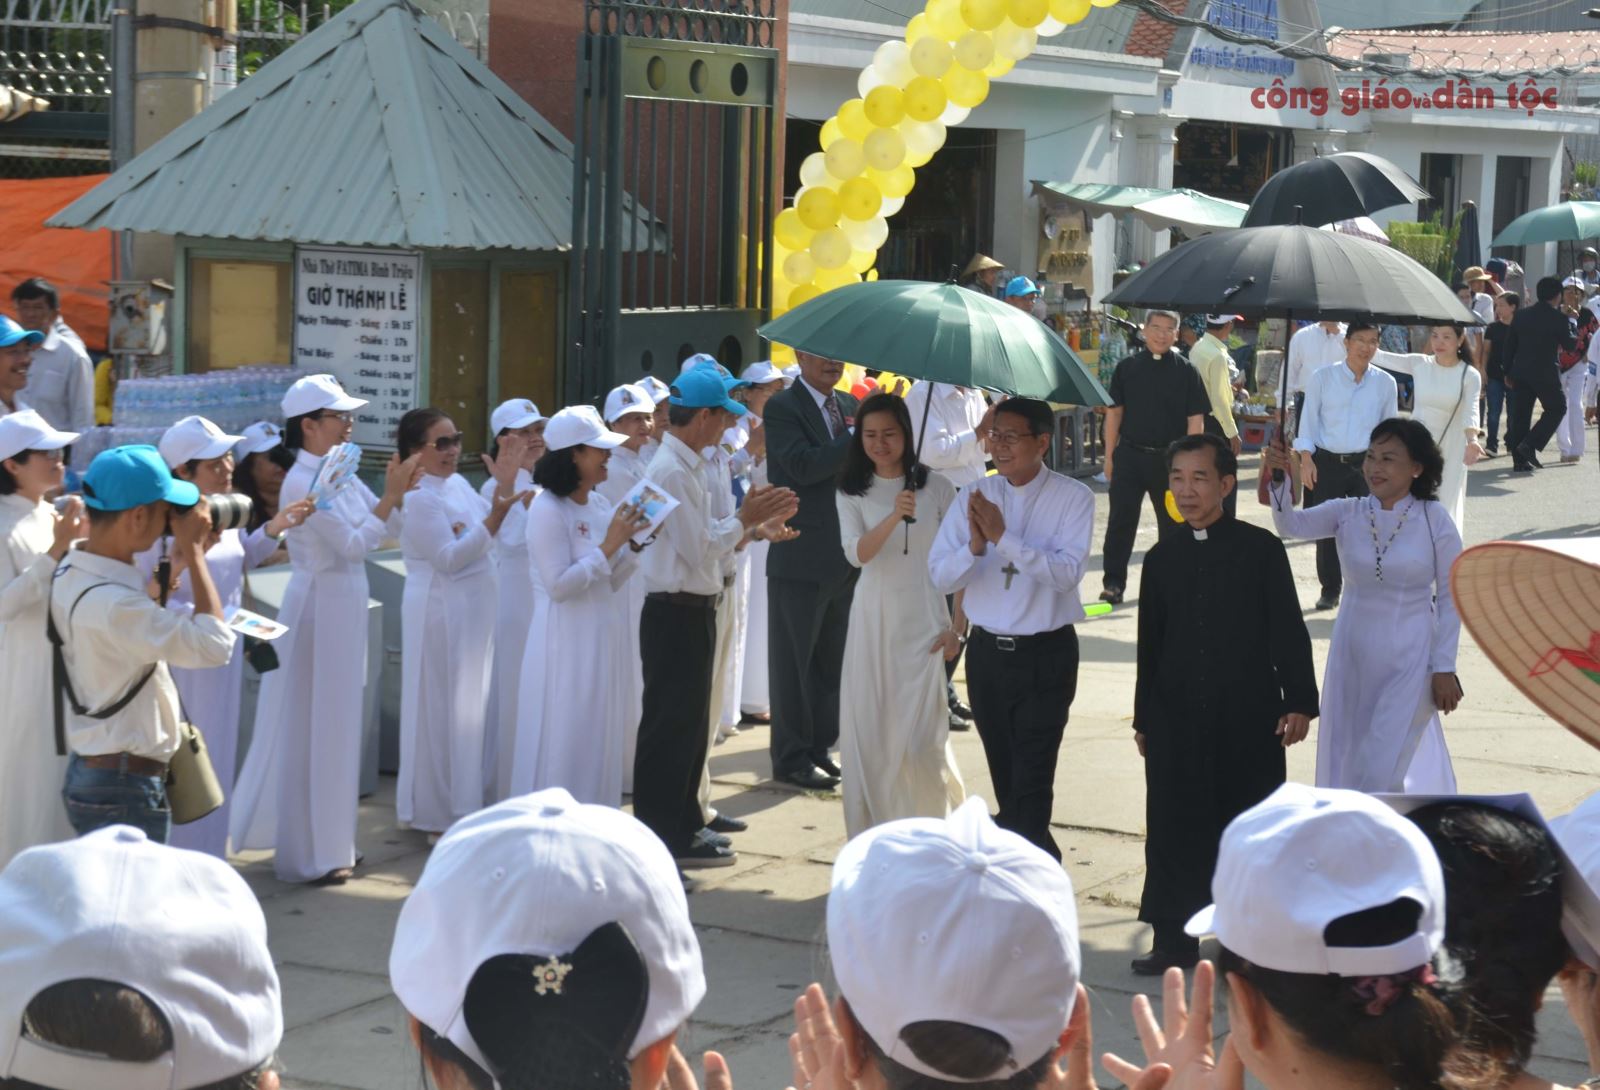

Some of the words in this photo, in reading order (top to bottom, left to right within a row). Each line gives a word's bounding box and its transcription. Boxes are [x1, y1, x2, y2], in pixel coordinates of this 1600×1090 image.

[336, 259, 369, 277] FATIMA
[307, 282, 332, 306] GIỜ
[336, 285, 386, 310] THÁNH
